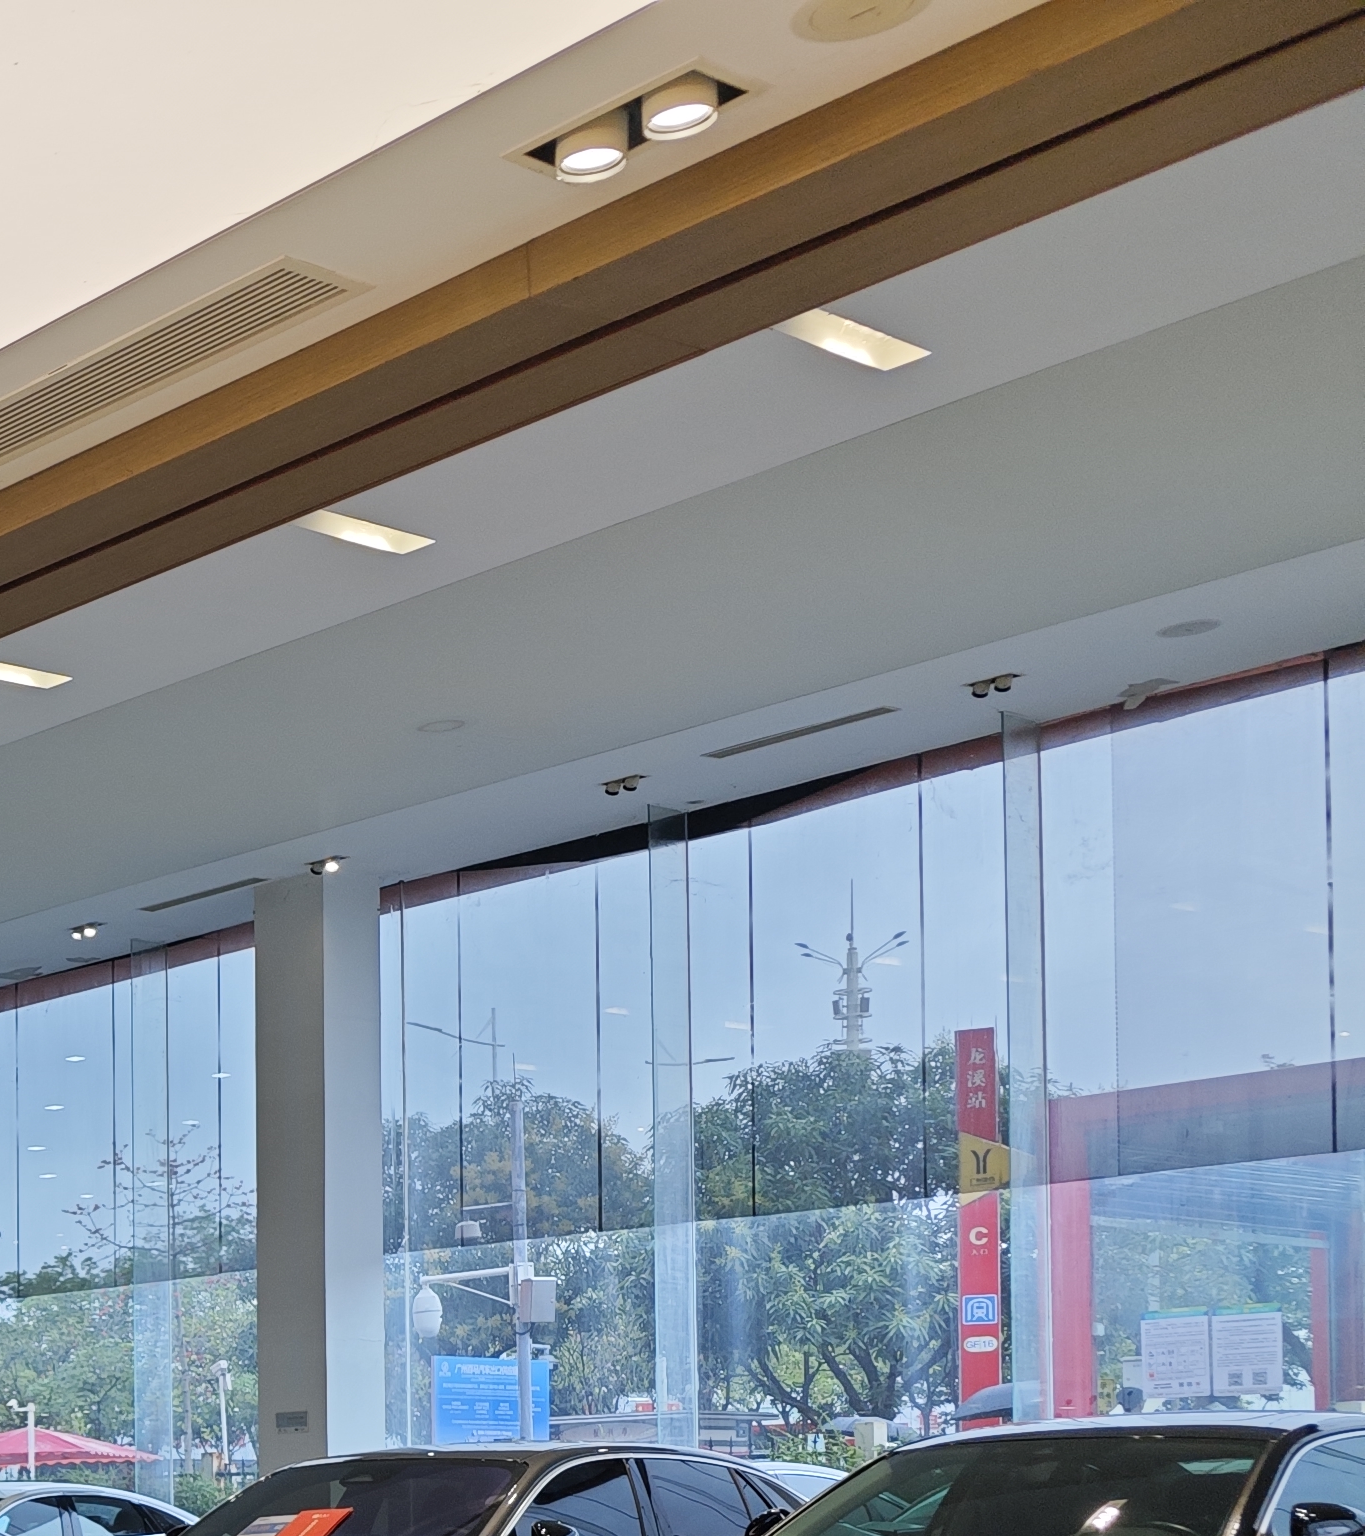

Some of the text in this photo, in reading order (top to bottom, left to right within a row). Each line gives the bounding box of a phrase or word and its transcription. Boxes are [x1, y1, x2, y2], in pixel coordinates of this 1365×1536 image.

[967, 1047, 986, 1109] 龙溪站
[969, 1226, 988, 1245] C
